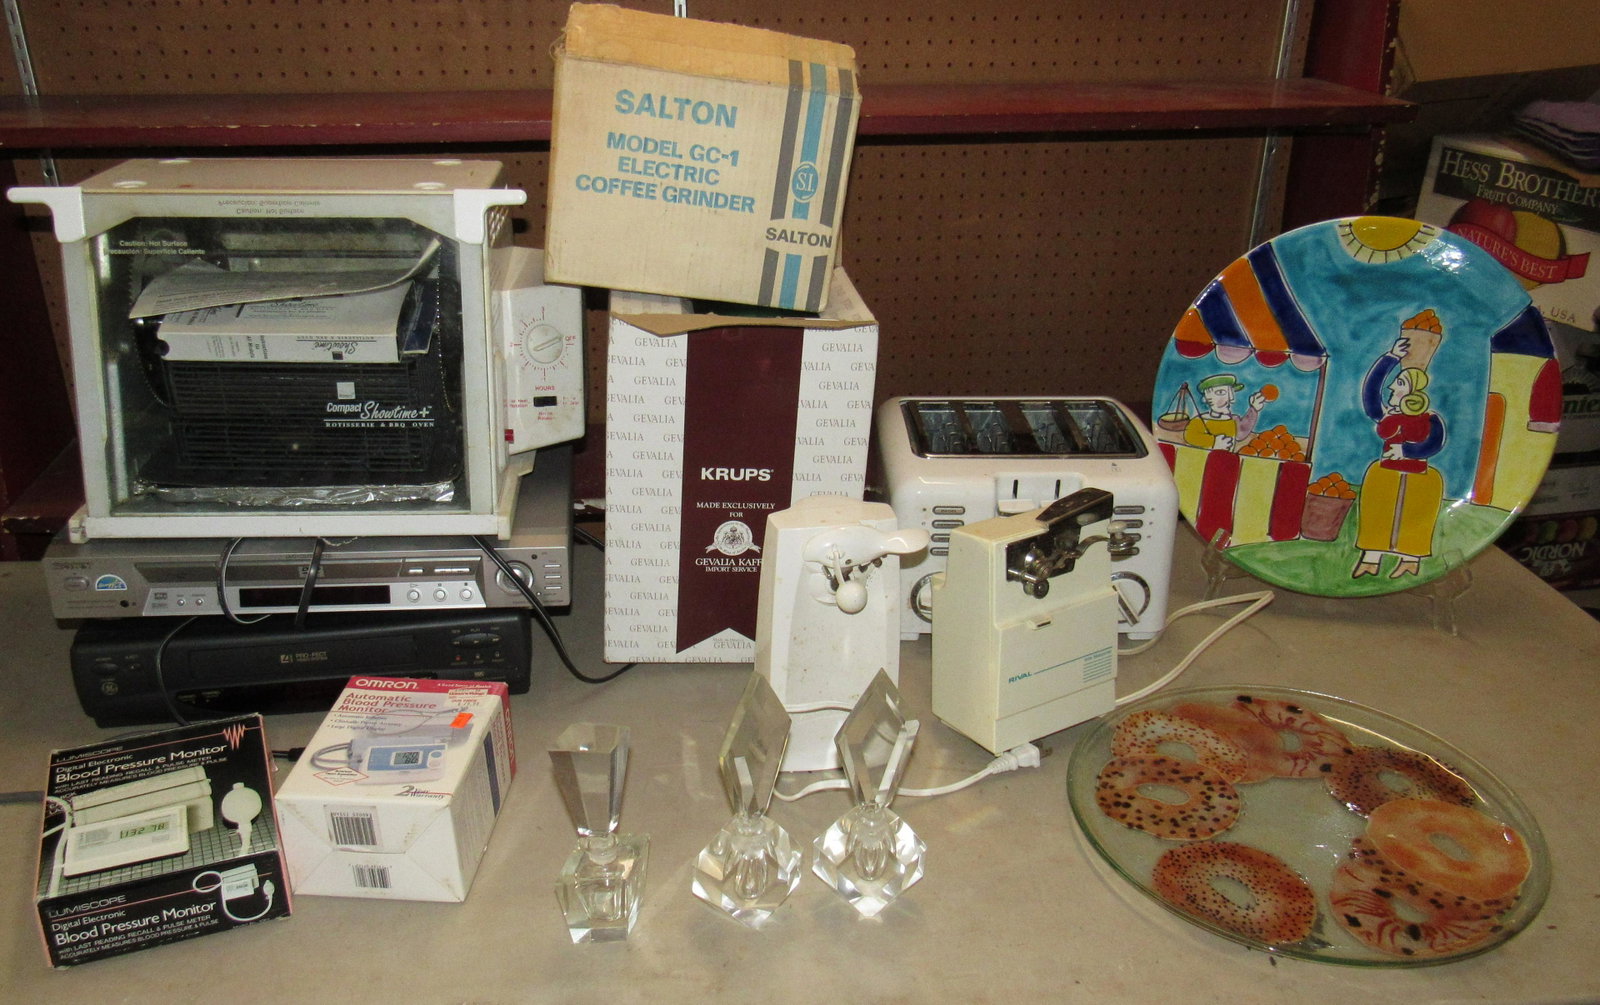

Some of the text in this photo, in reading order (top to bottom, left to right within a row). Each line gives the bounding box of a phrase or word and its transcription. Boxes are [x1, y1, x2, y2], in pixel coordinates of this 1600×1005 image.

[615, 88, 738, 129] SALTON
[606, 132, 739, 167] MODEL GC-1
[617, 156, 721, 186] ELECTRIC
[1441, 150, 1491, 182] HESS
[575, 174, 755, 214] COFFEE GRINDER
[1476, 185, 1559, 214] FRUIT COMPANY
[766, 227, 832, 249] SALTON
[1457, 227, 1558, 279] NATURE'S BEST
[1550, 305, 1576, 323] USA
[635, 337, 677, 348] GEVALIA
[822, 343, 863, 352] GEVALIA
[665, 359, 687, 367] GEV
[801, 362, 831, 371] VALIA
[634, 376, 676, 386] GEVALIA
[819, 381, 859, 391] GEVALIA
[664, 396, 685, 405] GEV
[799, 400, 828, 409] VALIA
[326, 402, 361, 414] Compact
[633, 414, 675, 424] GEVALIA
[816, 418, 856, 428] GEVALIA
[663, 434, 683, 443] GEV
[796, 437, 824, 446] VALIA
[632, 451, 674, 461] GEVALIA
[812, 455, 853, 464] GEVALIA
[662, 470, 682, 479] GEV
[701, 467, 771, 481] KRUPS
[794, 473, 822, 481] VALIA
[631, 487, 673, 497] GEVALIA
[661, 506, 681, 514] GEV
[722, 502, 776, 510] EXCLUSIVELY
[631, 522, 671, 532] GEVALIA
[660, 541, 680, 549] GEV
[1519, 542, 1587, 562] NORDIC
[630, 558, 671, 567] GEVALIA
[695, 558, 736, 567] GEVALIA
[659, 576, 679, 584] GEV
[630, 591, 669, 601] GEVALIA
[658, 609, 677, 617] GEV
[629, 624, 668, 633] GEVALIA
[607, 640, 640, 648] EVALIA
[713, 641, 752, 649] GEVALIA
[1008, 672, 1033, 684] RIVAL
[355, 678, 418, 690] OMRON
[346, 692, 411, 702] Automatic
[337, 704, 388, 714] Monitor
[342, 699, 437, 710] Blood Pressure
[56, 745, 124, 763] LUMISCOPE
[56, 754, 134, 775] Digital Electronic
[56, 745, 228, 784] Blood Pressure Monitor
[71, 780, 91, 788] LAST
[162, 760, 185, 769] PULSE
[186, 755, 212, 764] METER
[394, 785, 415, 797] 2
[48, 894, 127, 918] LUMISCOPE
[51, 910, 127, 932] Digital Electronic
[55, 901, 217, 946] Blood Pressure Monitor
[73, 943, 93, 951] LAST
[94, 935, 127, 947] READING
[127, 929, 155, 939] RECALL
[163, 920, 185, 930] PULSE
[186, 915, 211, 924] METER
[101, 939, 137, 951] MEASURES
[137, 932, 160, 943] BLOOD
[160, 925, 193, 937] PRESSURE
[200, 919, 219, 928] PULSE
